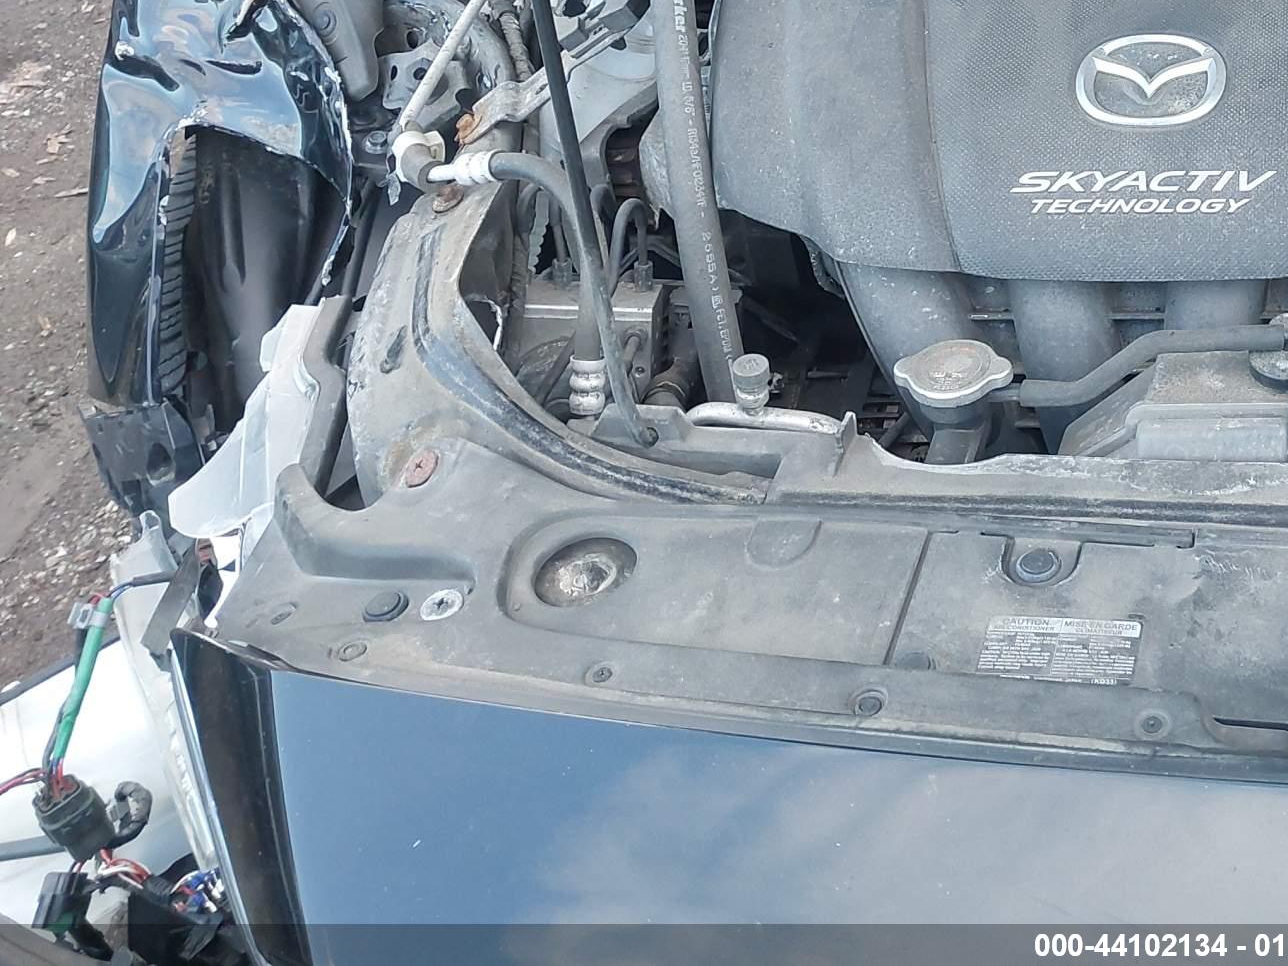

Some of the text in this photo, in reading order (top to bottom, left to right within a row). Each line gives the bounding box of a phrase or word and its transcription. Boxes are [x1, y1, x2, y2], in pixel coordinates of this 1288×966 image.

[1010, 170, 1277, 193] SKYACTIV
[1030, 198, 1252, 214] TECHNOLOGY
[1002, 618, 1050, 626] CAUTION
[1064, 620, 1087, 628] MISE
[1104, 622, 1138, 631] GARDE
[1007, 625, 1055, 633] CONDITIONER
